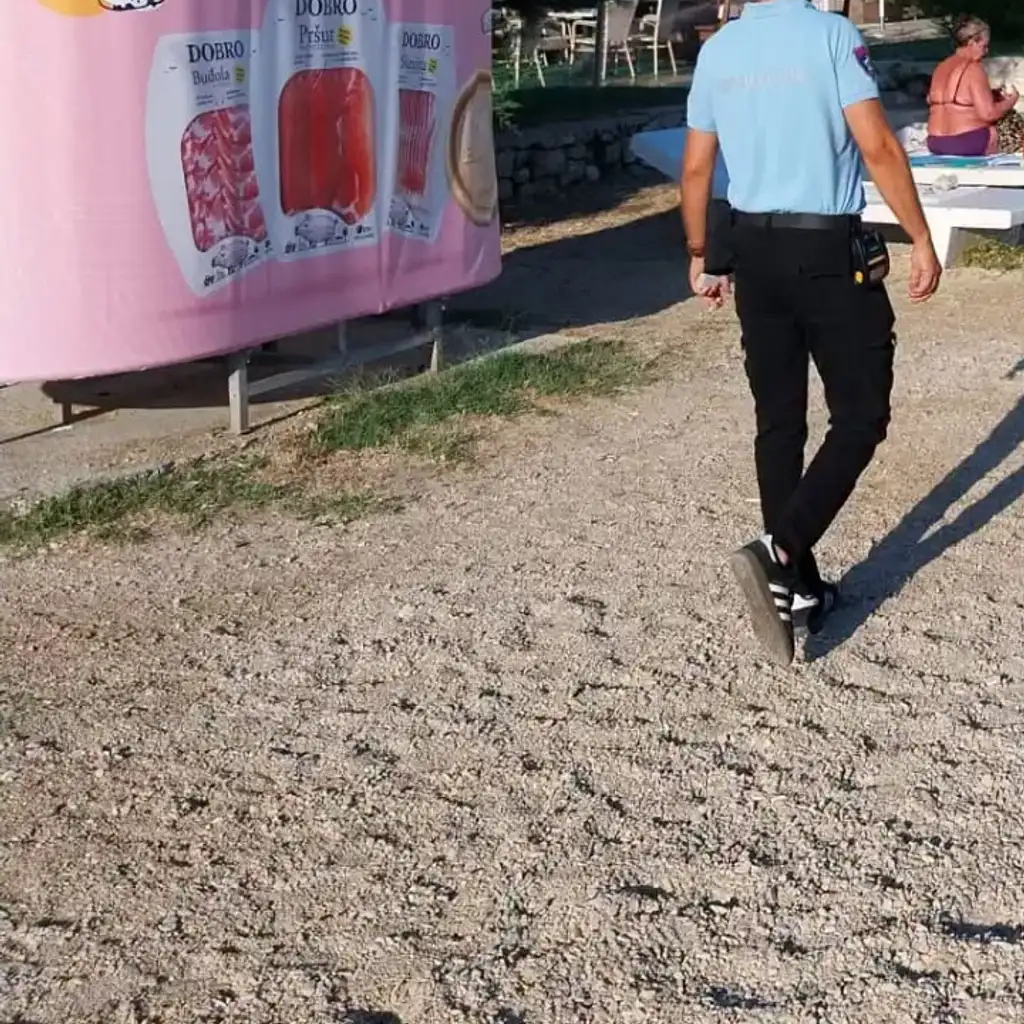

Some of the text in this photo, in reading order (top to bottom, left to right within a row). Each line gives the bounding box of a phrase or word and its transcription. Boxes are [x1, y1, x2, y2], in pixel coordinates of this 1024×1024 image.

[299, 23, 335, 44] Pršut
[402, 31, 441, 50] DOBRO
[187, 40, 245, 64] DOBRO
